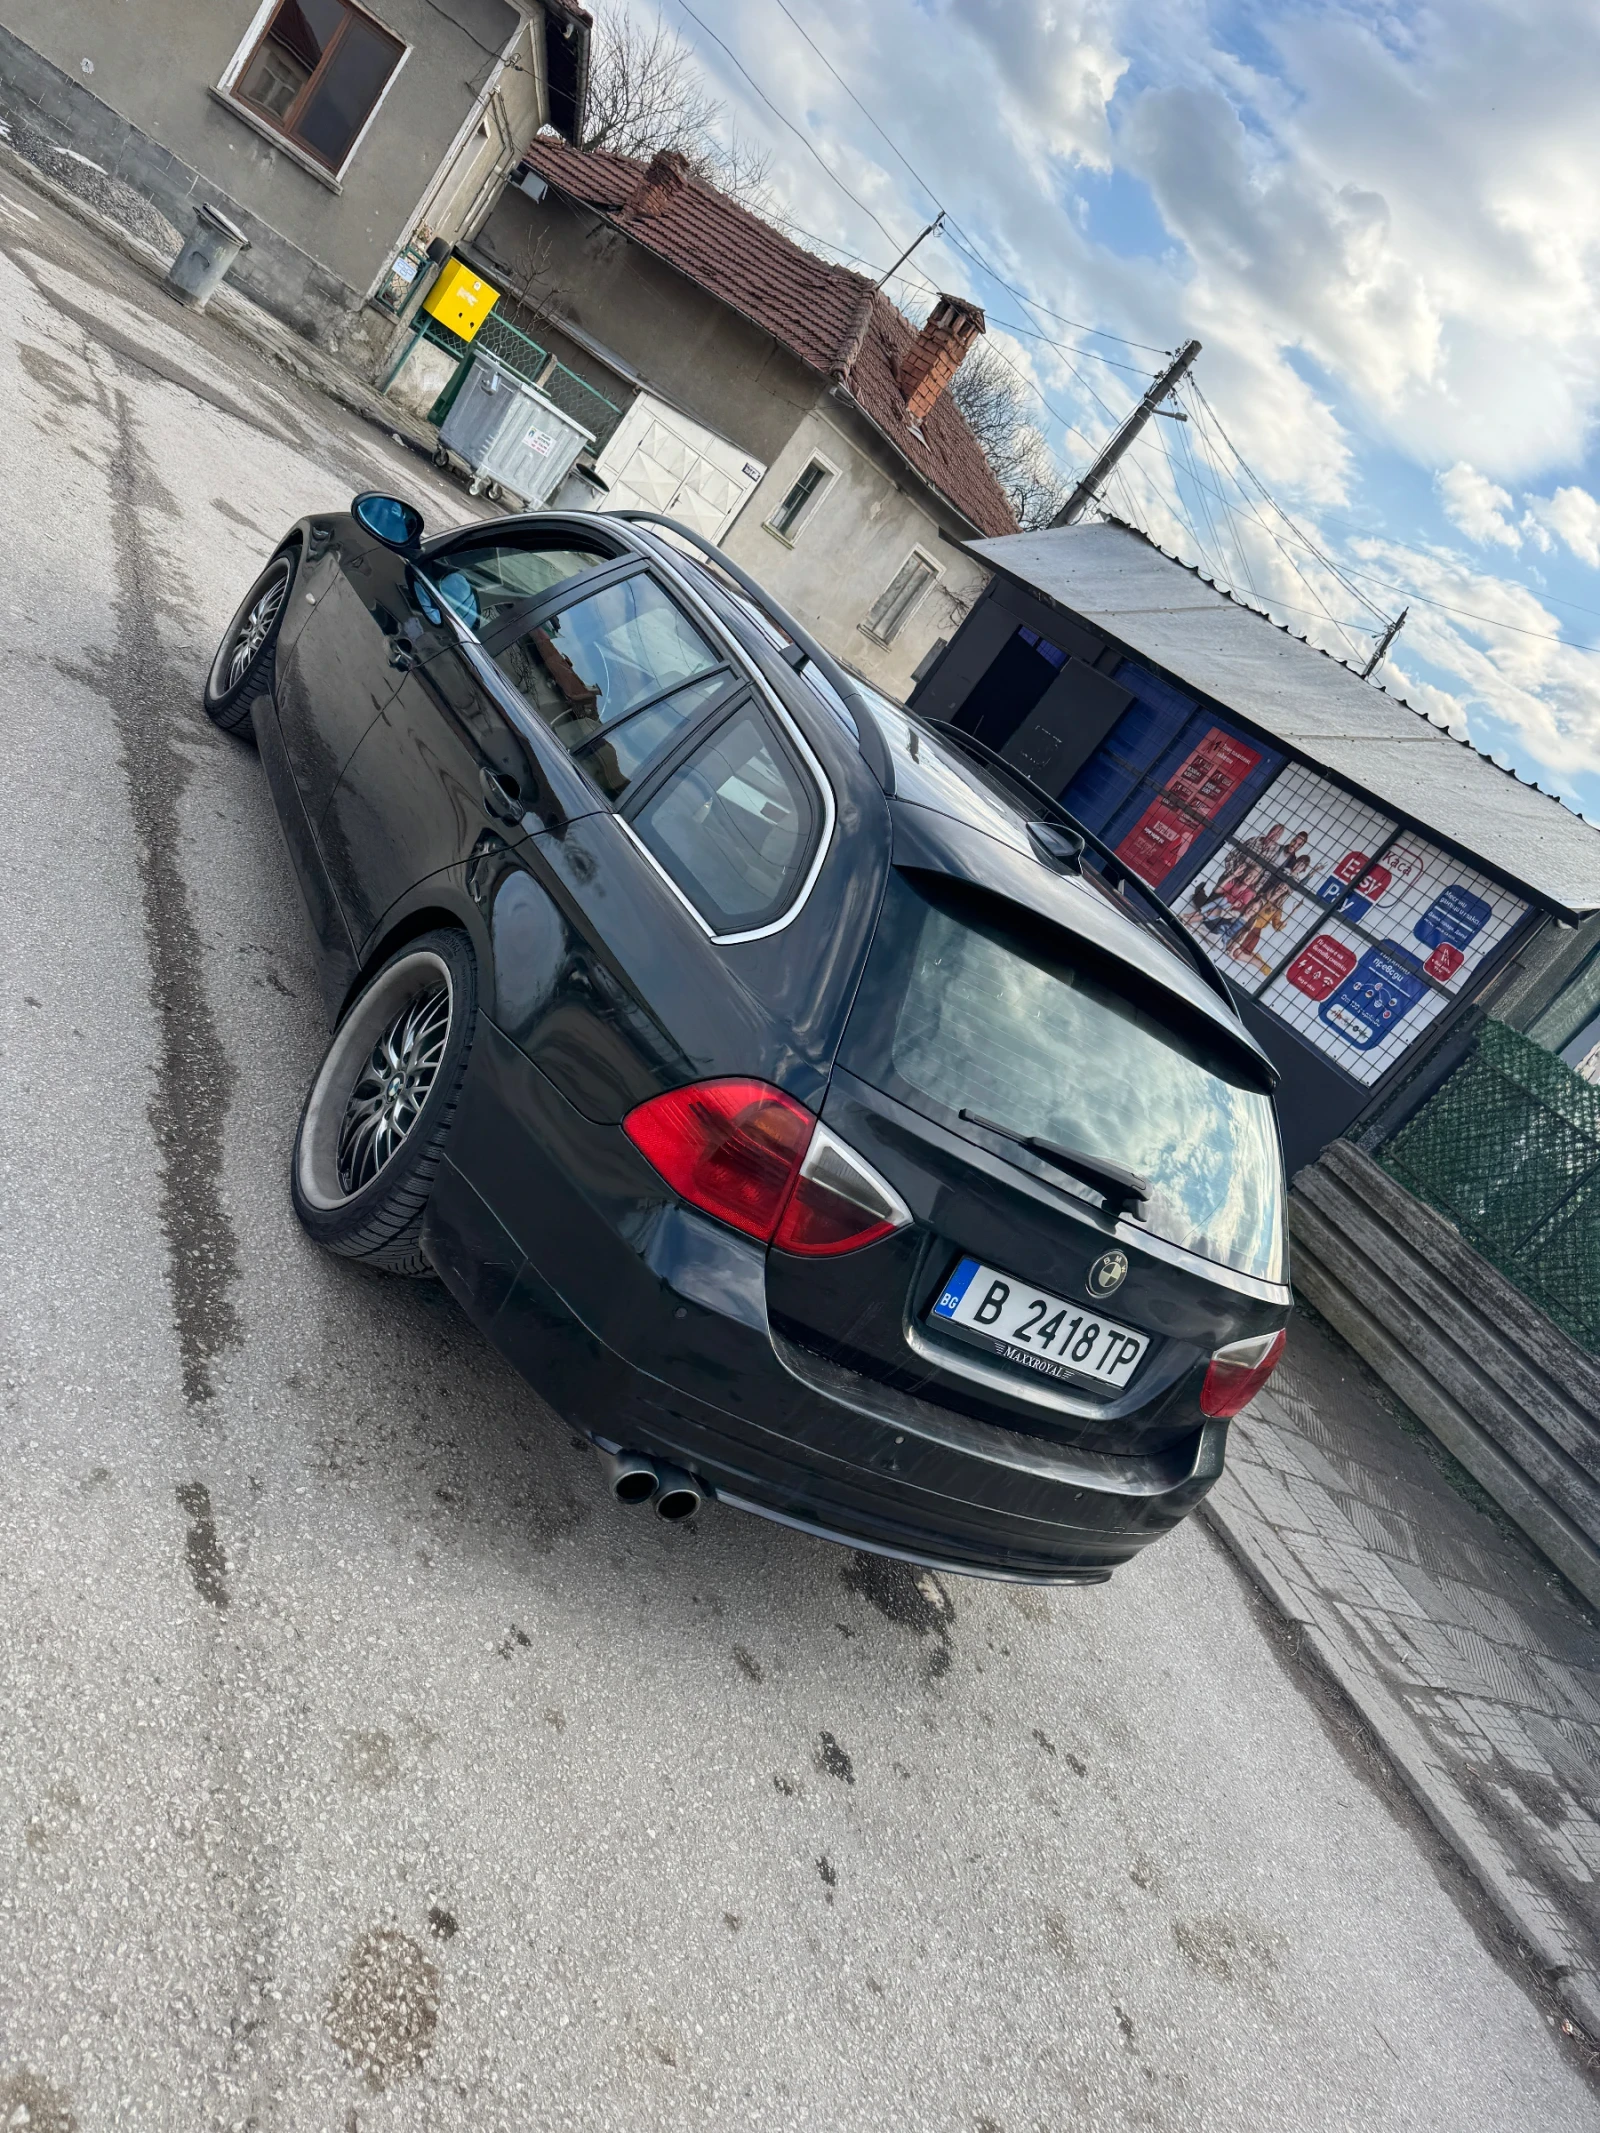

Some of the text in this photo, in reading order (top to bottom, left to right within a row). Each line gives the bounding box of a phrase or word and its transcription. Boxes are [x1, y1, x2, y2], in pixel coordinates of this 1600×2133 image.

[1383, 851, 1412, 876] Каса
[1323, 882, 1354, 912] Py
[940, 1293, 959, 1309] BG
[973, 1279, 1010, 1325] B
[1012, 1300, 1100, 1362] 2418
[1004, 1346, 1064, 1378] MAXXROYAL
